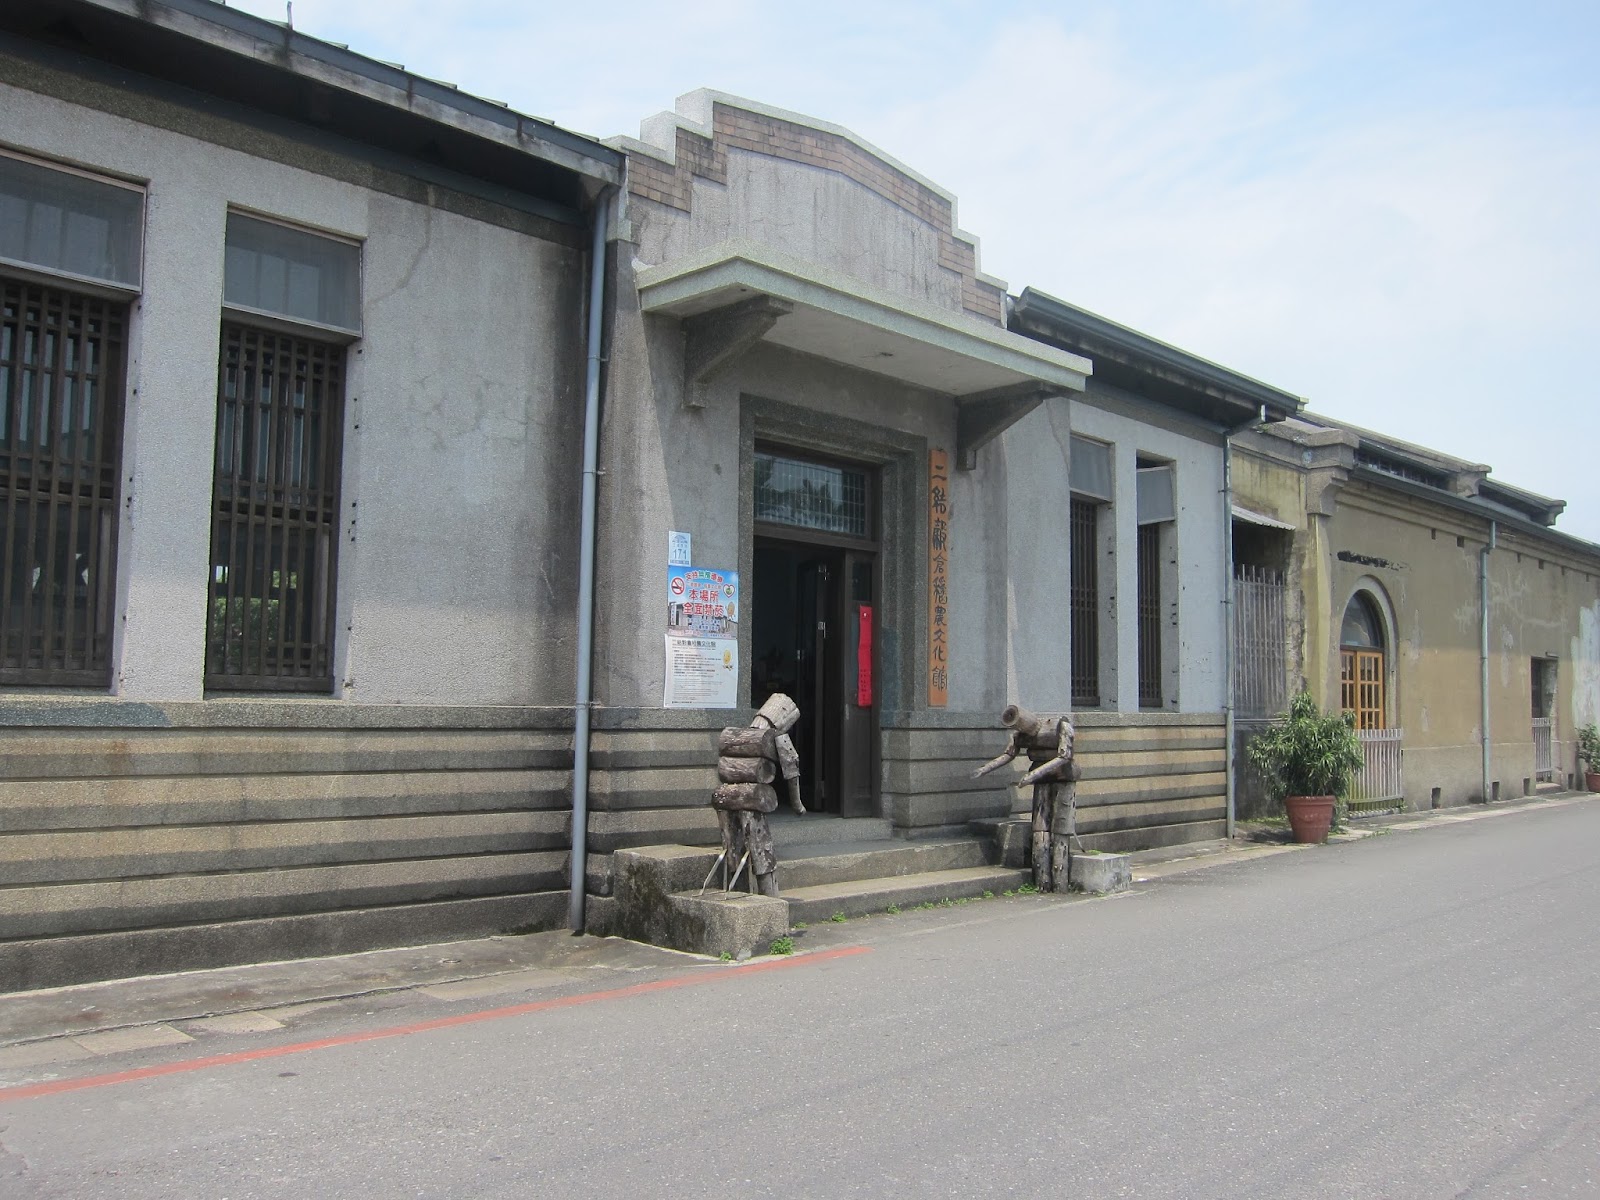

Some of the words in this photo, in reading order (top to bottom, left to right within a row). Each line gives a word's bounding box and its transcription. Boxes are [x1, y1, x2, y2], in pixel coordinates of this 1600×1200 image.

[673, 548, 687, 560] 171
[688, 589, 720, 602] 本場所
[683, 602, 724, 617] 全面禁菸
